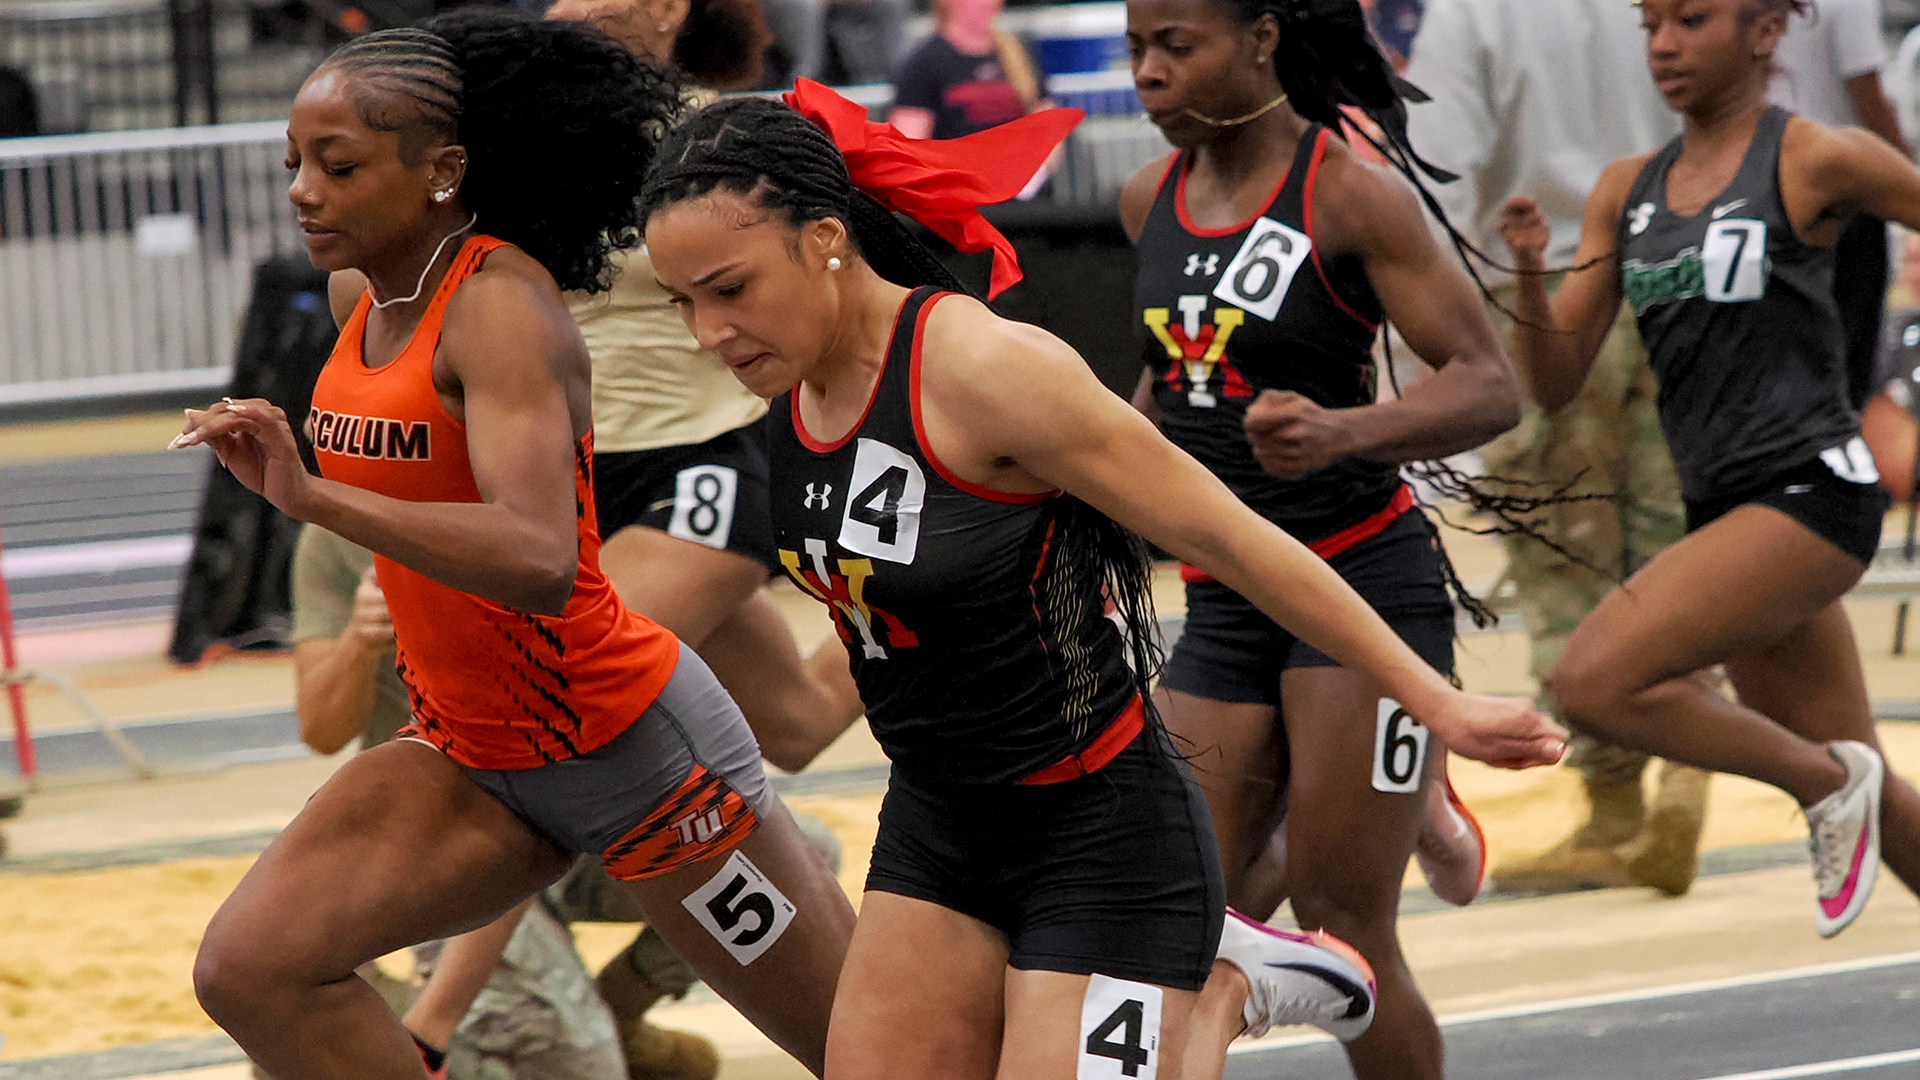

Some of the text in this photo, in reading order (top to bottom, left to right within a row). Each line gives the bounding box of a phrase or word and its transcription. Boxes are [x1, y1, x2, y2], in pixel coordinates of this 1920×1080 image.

[1233, 230, 1292, 303] 6
[1721, 228, 1749, 295] 7
[688, 473, 722, 537] 8
[848, 464, 909, 546] 4
[1383, 707, 1421, 785] 6
[668, 804, 726, 848] TU
[705, 872, 775, 946] 5
[1086, 998, 1148, 1078] 4
